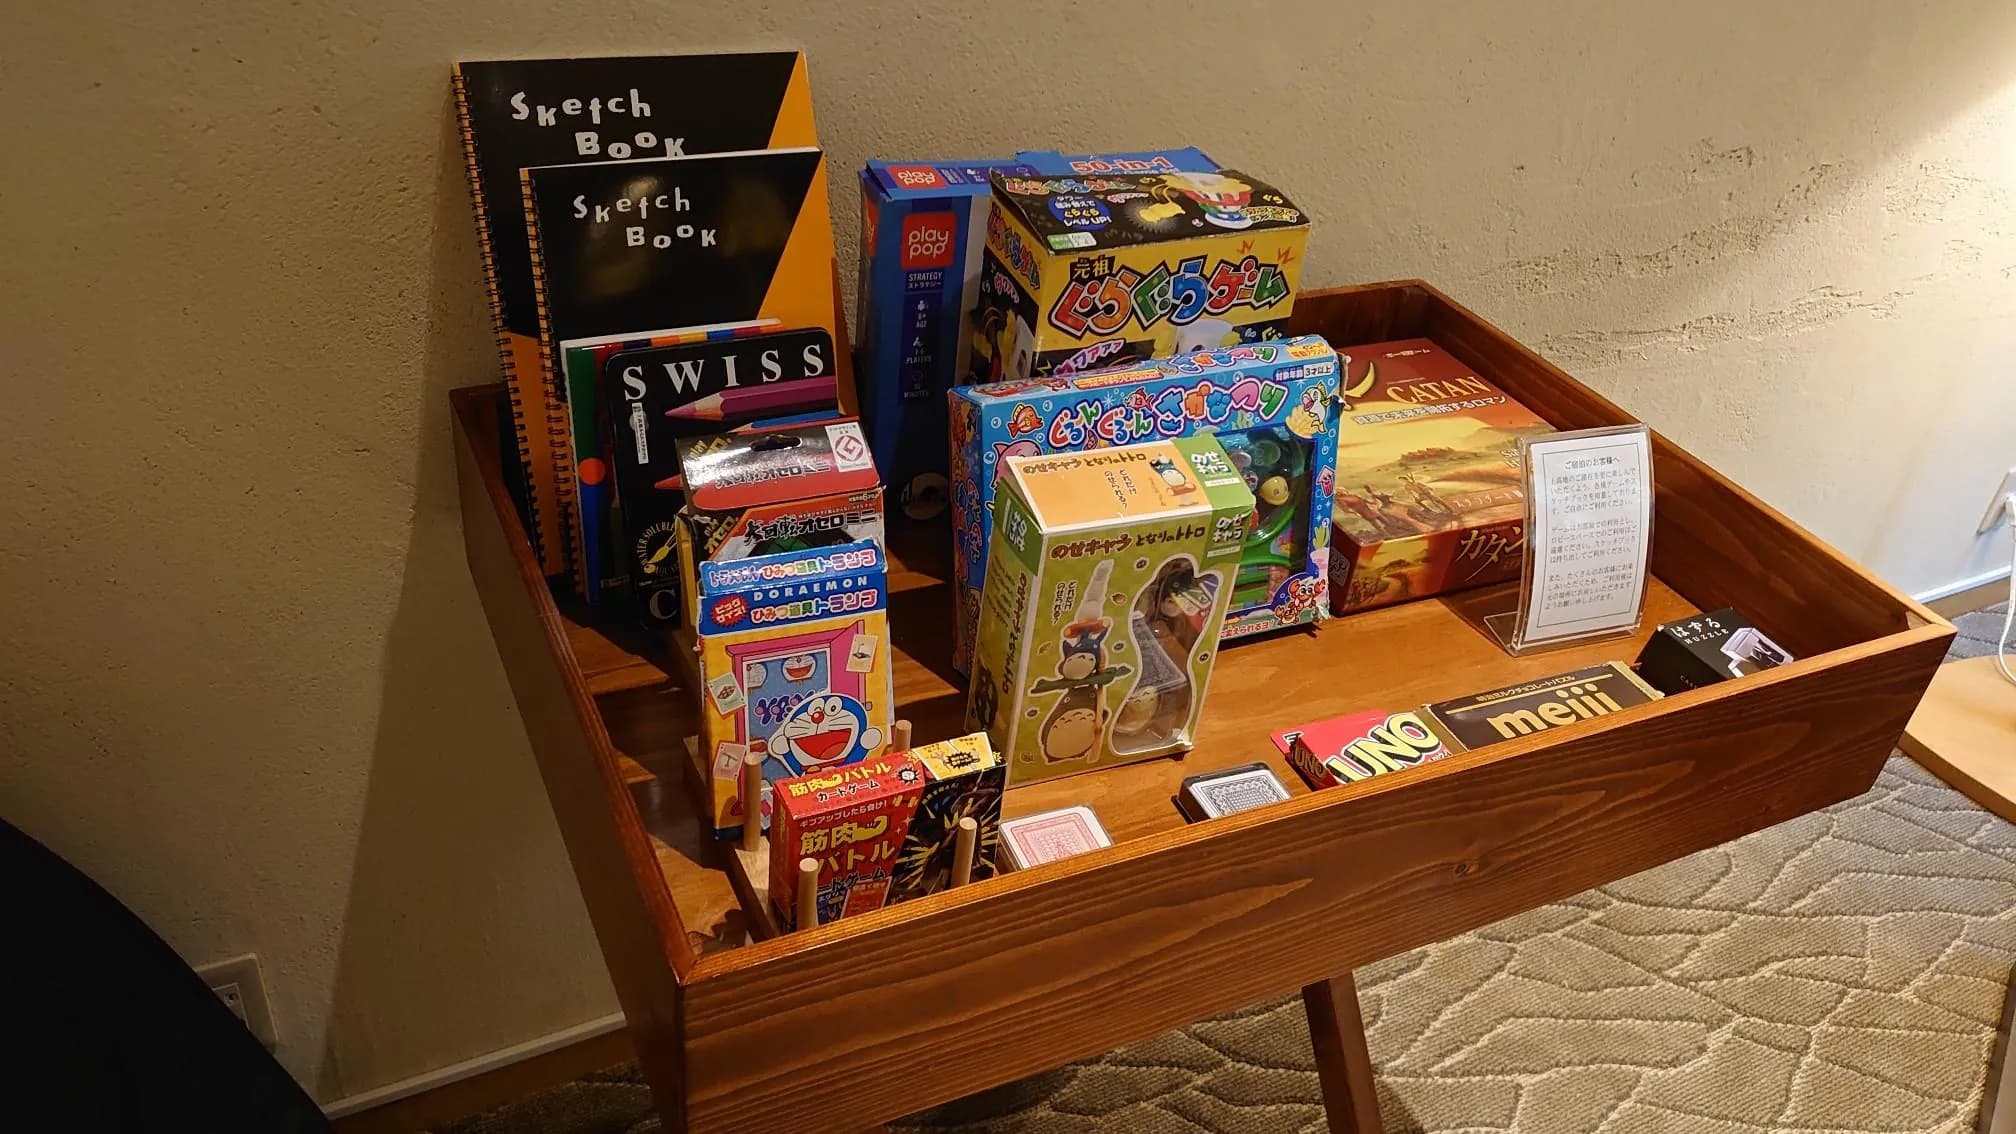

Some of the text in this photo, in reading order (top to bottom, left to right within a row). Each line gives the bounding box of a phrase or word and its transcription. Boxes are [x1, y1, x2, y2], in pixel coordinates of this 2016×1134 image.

[510, 88, 652, 126] Sketch
[898, 170, 936, 181] play
[1071, 156, 1174, 173] 50-in-1
[903, 177, 936, 185] pop
[572, 186, 691, 223] Sketch
[625, 223, 717, 249] Book
[908, 225, 949, 246] play
[909, 243, 945, 260] pop
[908, 271, 943, 282] STRATEGY
[1073, 257, 1111, 280] 元祖
[1049, 257, 1290, 339] ぐらぐらゲーム
[622, 344, 825, 401] SWISS
[1386, 376, 1491, 404] CATAN
[1022, 451, 1147, 475] のせキャラ となりのトトロ
[1190, 451, 1220, 464] のせ
[1197, 461, 1231, 474] キャラ
[744, 508, 877, 545] 大回転オセロミニ
[1216, 514, 1245, 528] のせ
[1051, 525, 1205, 560] のせキャラ となりのトトロ
[1212, 526, 1243, 543] キャラ
[1455, 526, 1523, 582] カタン
[753, 575, 869, 601] DORAEMON
[750, 589, 878, 624] ひみつ道具トランプ
[1684, 628, 1730, 645] HUZZLE
[1326, 711, 1441, 783] UNO
[1294, 746, 1326, 778] UNO
[817, 780, 881, 803] カードゲーム
[799, 801, 888, 828] ギブアップしたら負け!
[801, 821, 858, 855] 筋肉
[817, 839, 896, 873] バトル
[818, 867, 886, 893] ードゲーム
